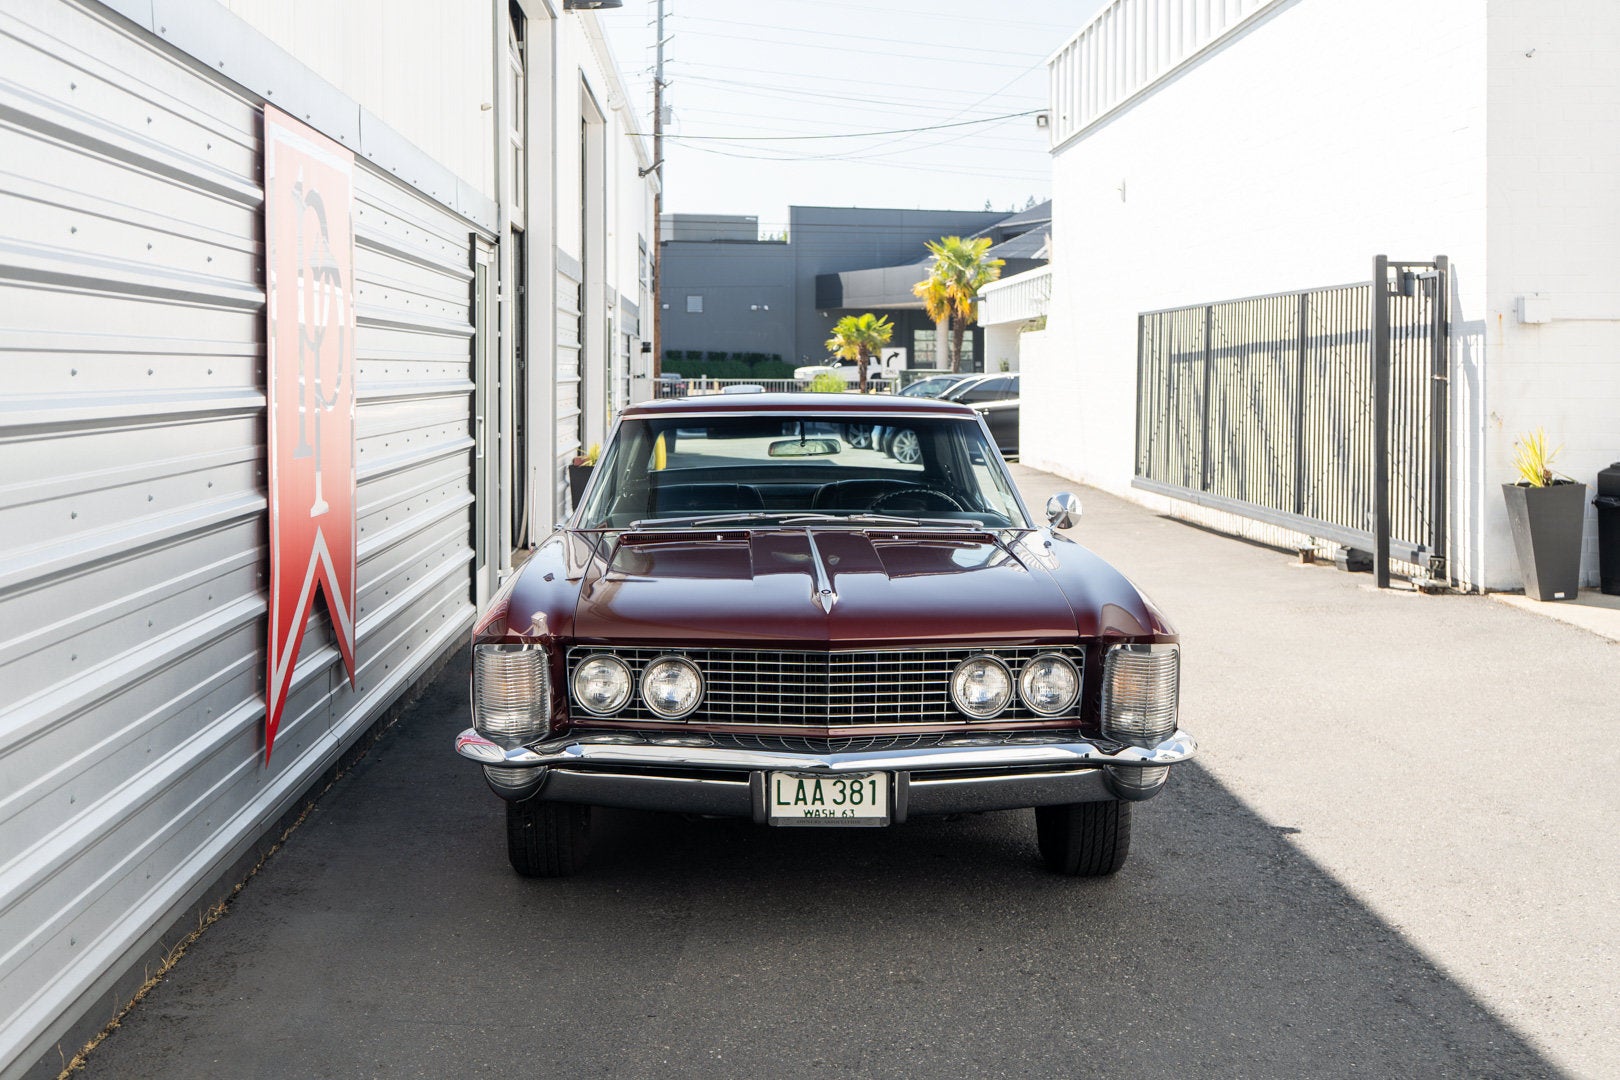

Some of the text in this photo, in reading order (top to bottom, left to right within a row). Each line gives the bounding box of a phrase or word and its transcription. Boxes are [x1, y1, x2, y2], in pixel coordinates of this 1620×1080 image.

[777, 779, 876, 805] LAA 381
[803, 809, 855, 818] WASH 63
